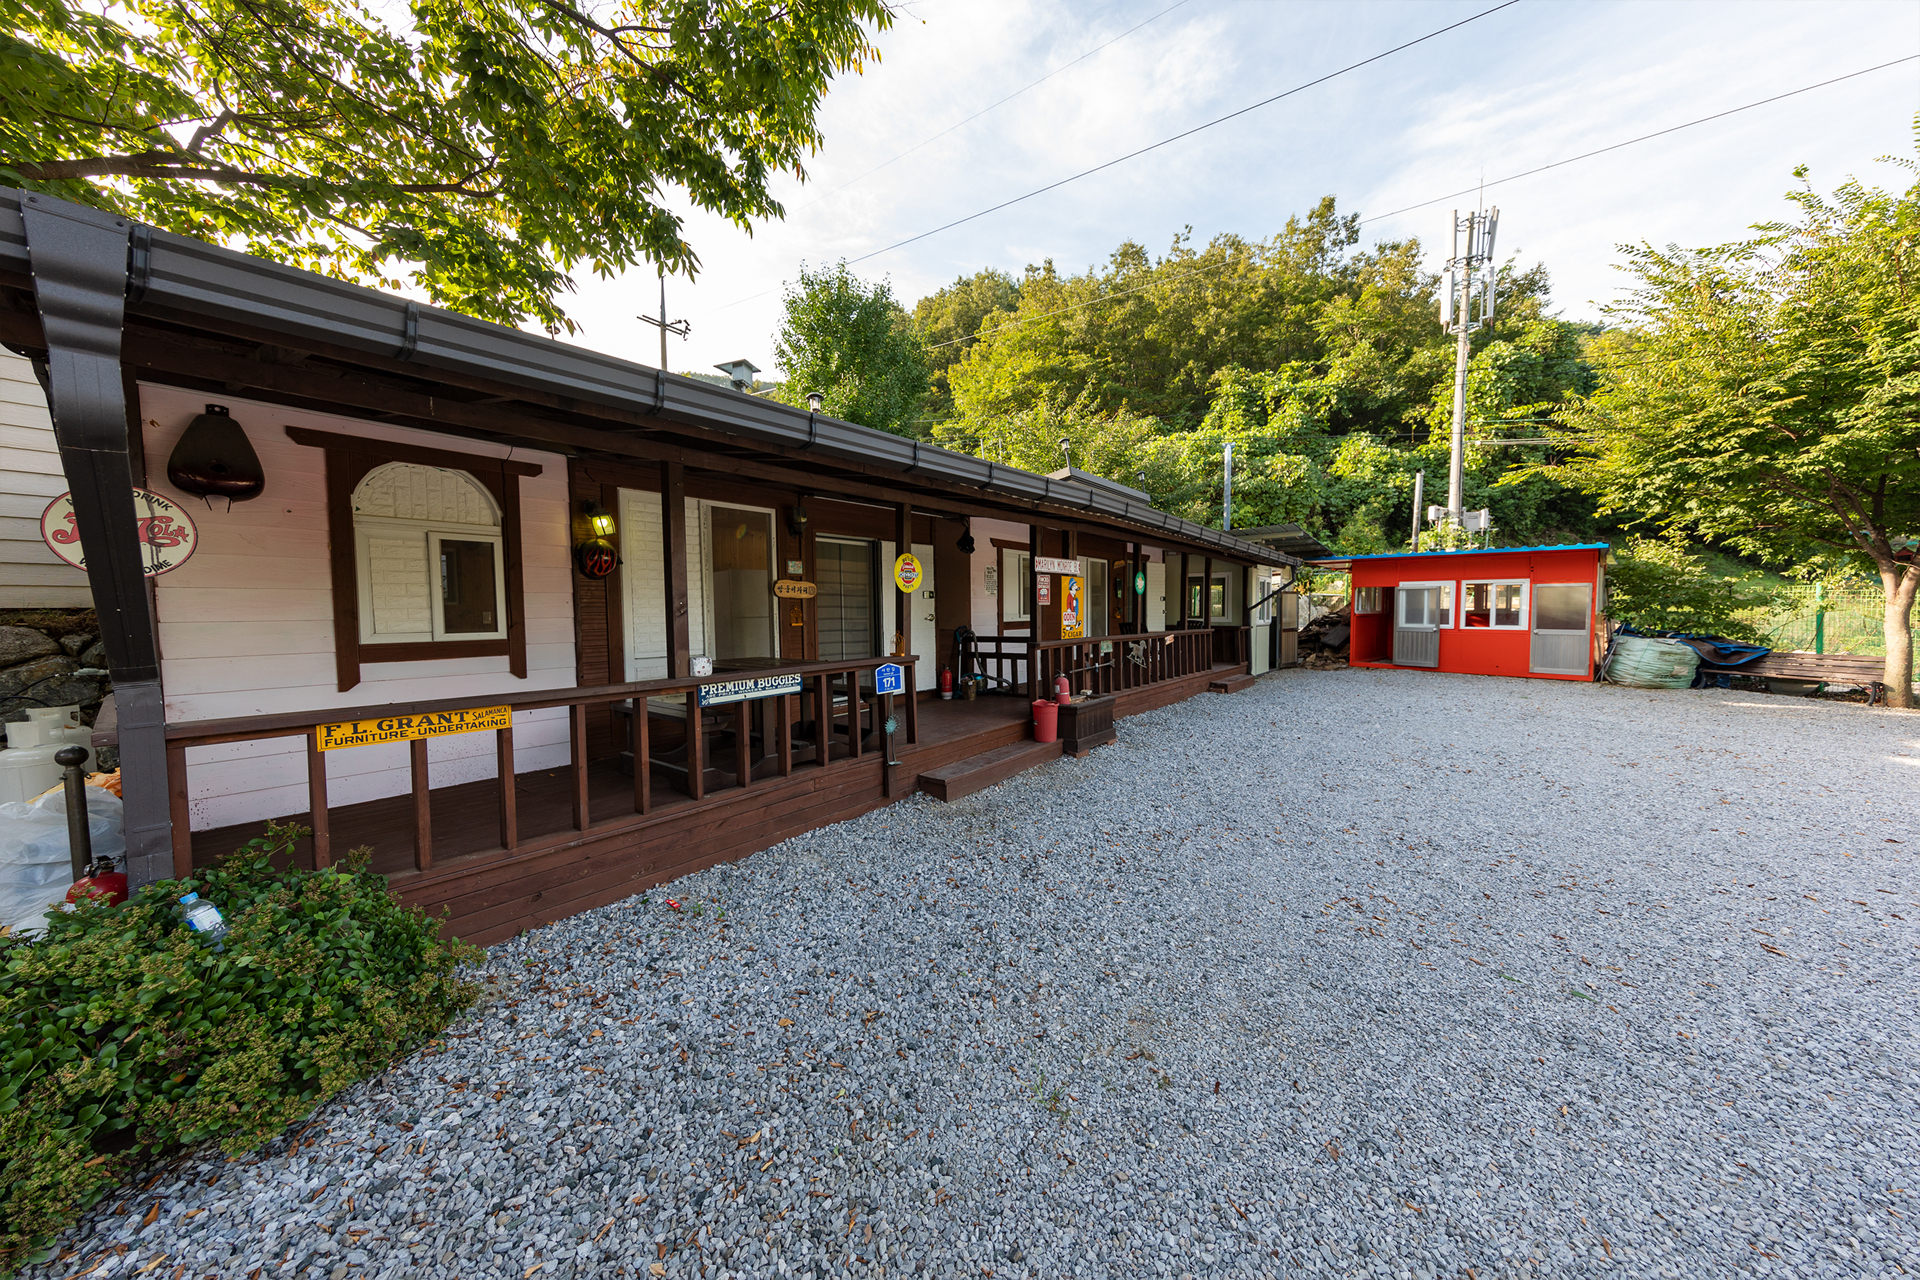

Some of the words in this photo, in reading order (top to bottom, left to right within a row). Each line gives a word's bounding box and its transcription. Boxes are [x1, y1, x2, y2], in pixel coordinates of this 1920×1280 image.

[132, 490, 174, 511] DRINK
[143, 559, 173, 574] DIME
[1038, 558, 1056, 571] MARILYN
[1056, 560, 1073, 572] MONROE
[1067, 630, 1083, 638] CIGAR
[700, 679, 755, 696] PREMIUM
[757, 673, 802, 688] BUGGIES
[882, 676, 896, 688] 171
[376, 711, 470, 732] GRANT
